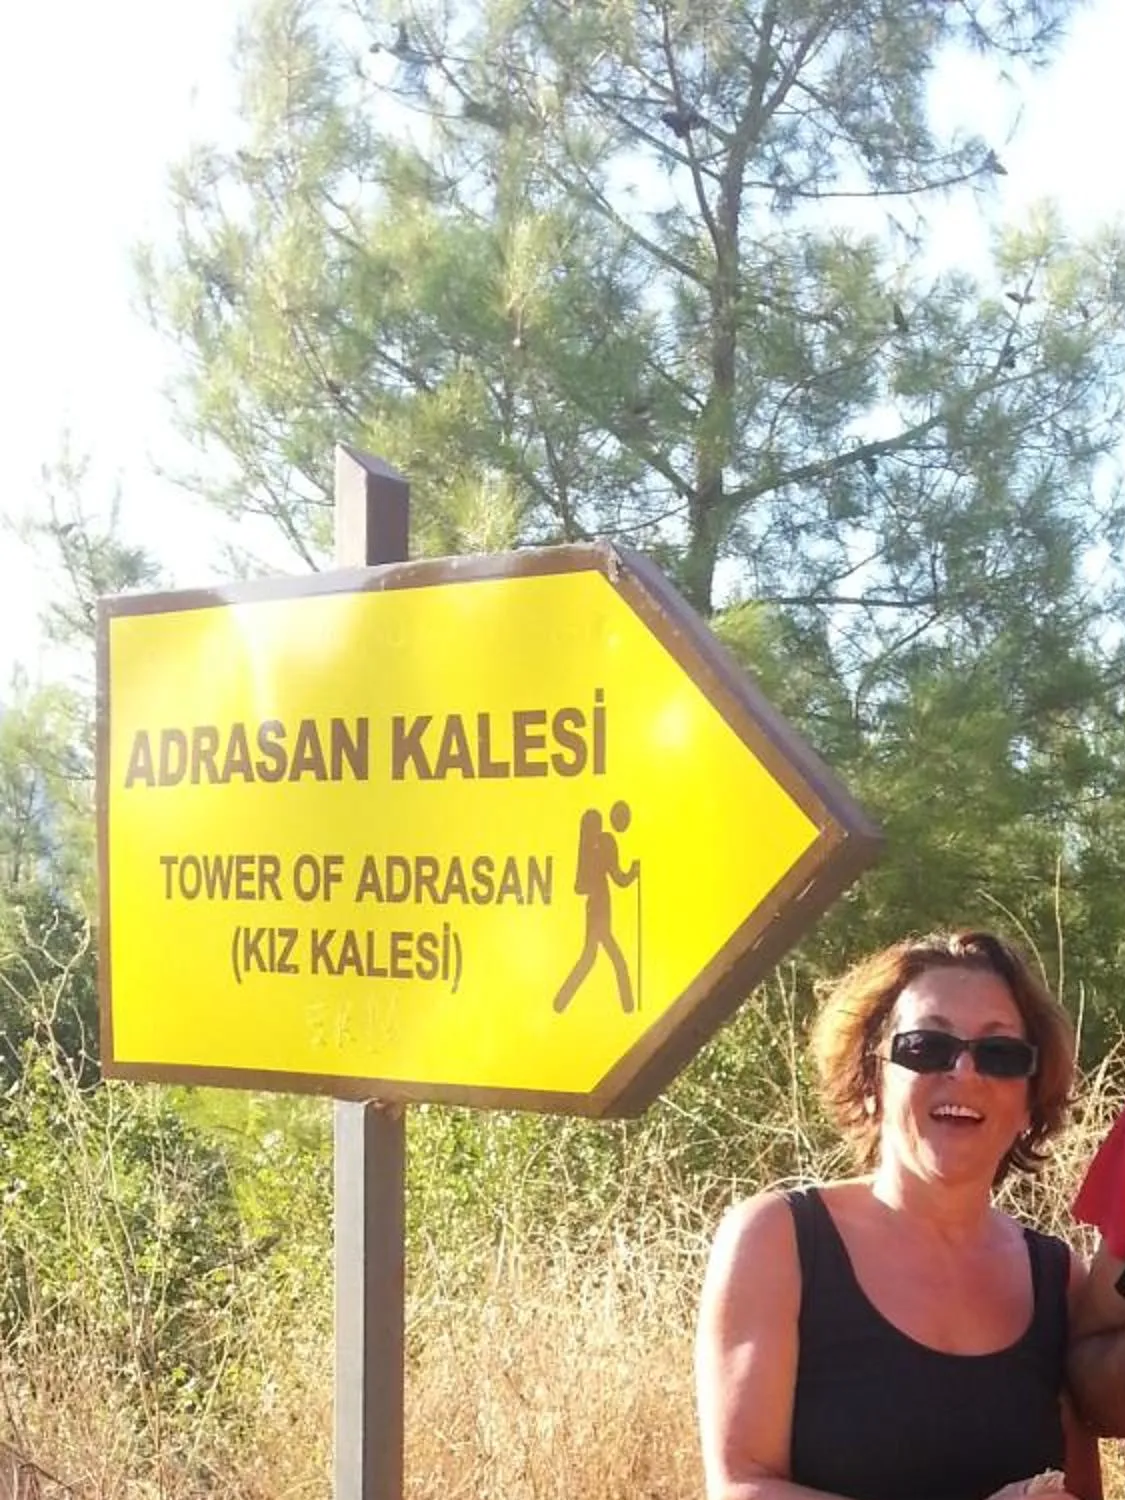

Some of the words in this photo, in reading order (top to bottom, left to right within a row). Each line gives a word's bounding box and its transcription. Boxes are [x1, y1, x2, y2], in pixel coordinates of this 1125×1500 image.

[125, 717, 370, 788] ADRASAN
[391, 687, 607, 781] KALESİ
[159, 855, 283, 902] TOWER
[293, 854, 345, 902] OF
[354, 855, 554, 906] ADRASAN
[231, 926, 300, 984] (KIZ
[310, 921, 463, 994] KALESİ)
